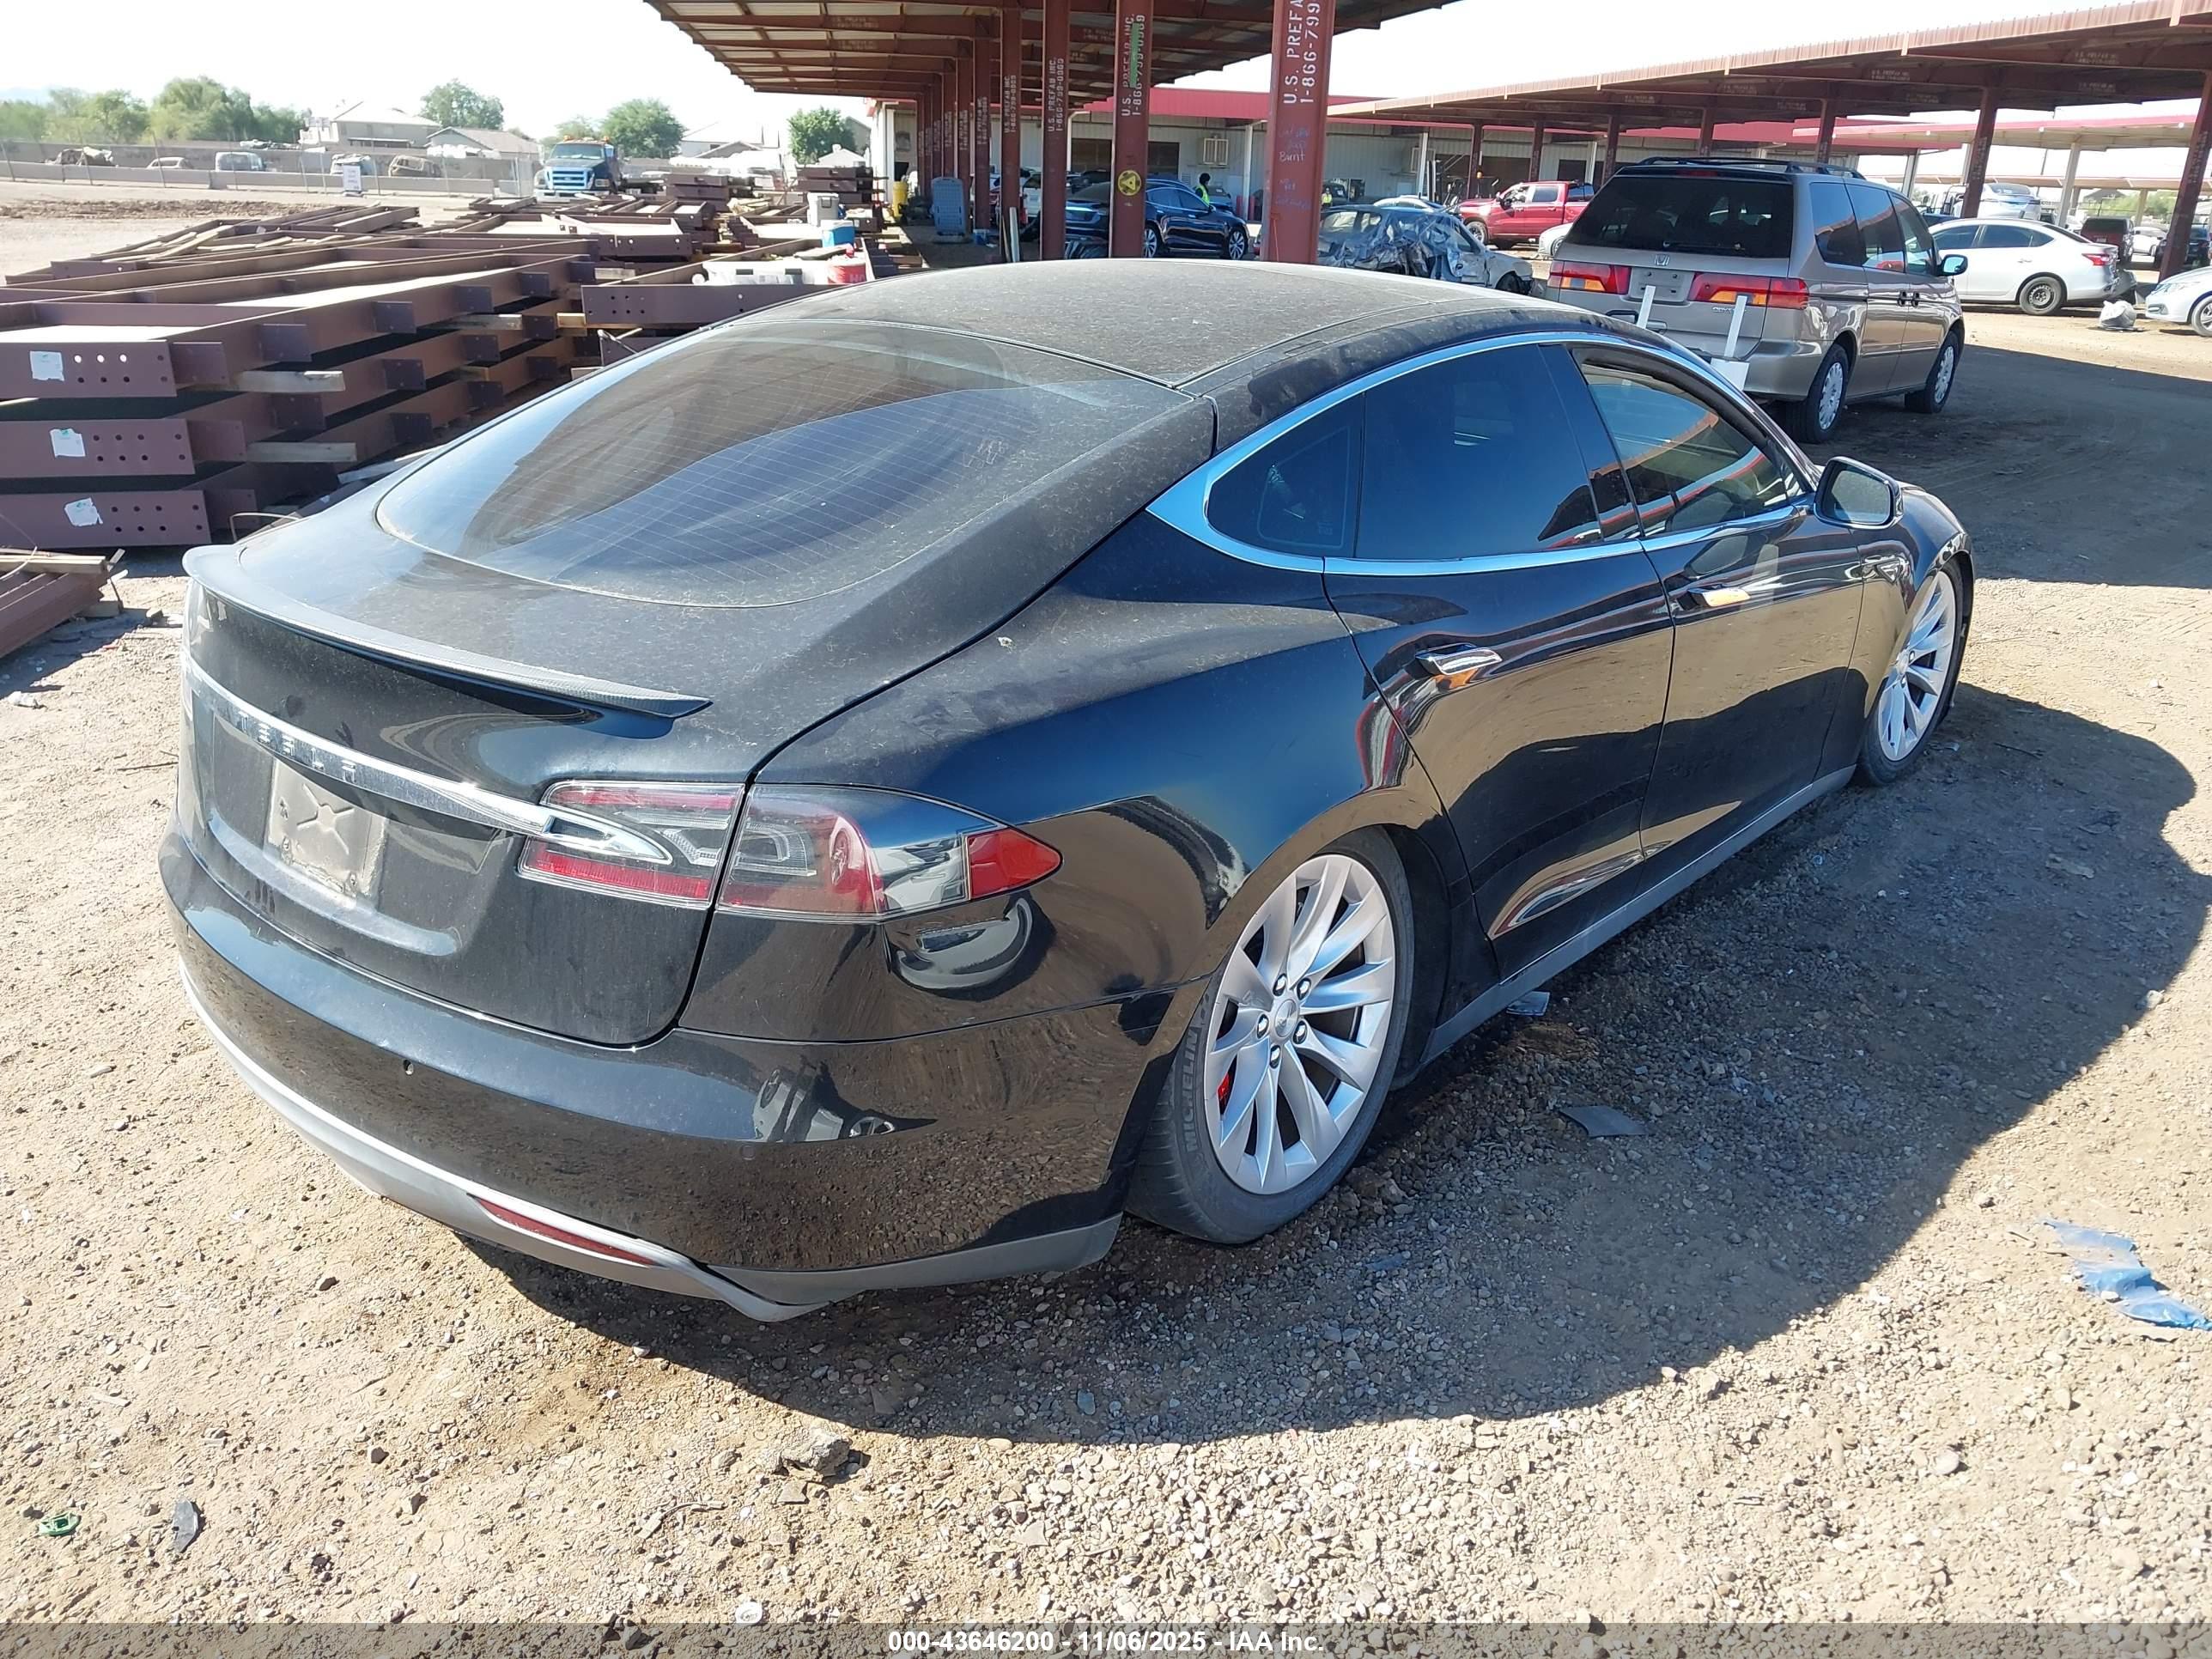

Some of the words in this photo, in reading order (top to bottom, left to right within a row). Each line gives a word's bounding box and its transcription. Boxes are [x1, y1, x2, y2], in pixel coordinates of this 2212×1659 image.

[1121, 94, 1133, 116] U.S.
[1283, 70, 1299, 104] U.S.
[237, 710, 357, 784] TESLA
[1182, 1028, 1200, 1153] MICHELIN
